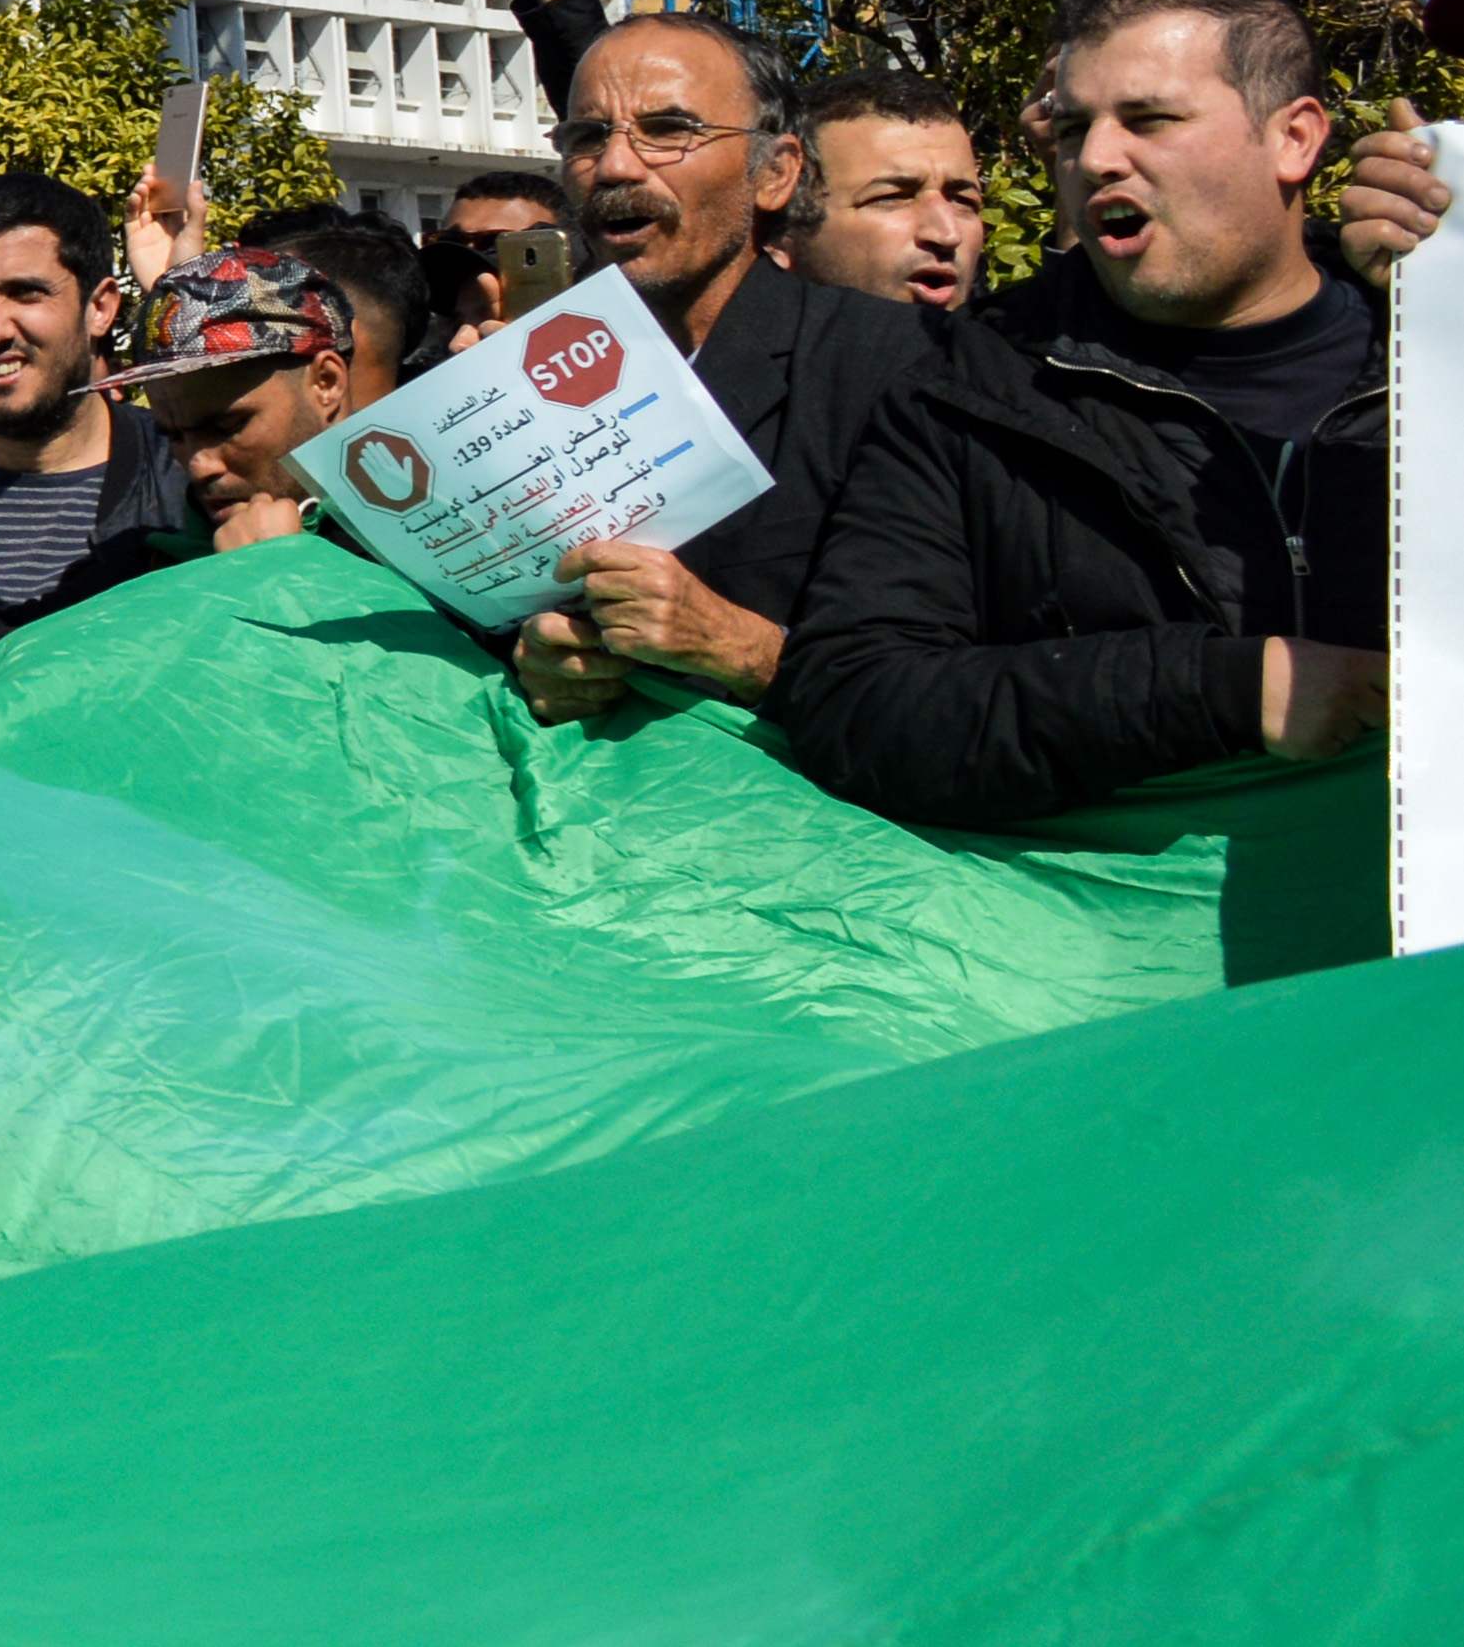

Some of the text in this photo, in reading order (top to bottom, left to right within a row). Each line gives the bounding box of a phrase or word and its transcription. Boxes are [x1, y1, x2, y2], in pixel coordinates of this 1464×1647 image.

[531, 330, 611, 390] STOP
[453, 408, 535, 467] المادة 139:
[570, 429, 631, 477] للوصول
